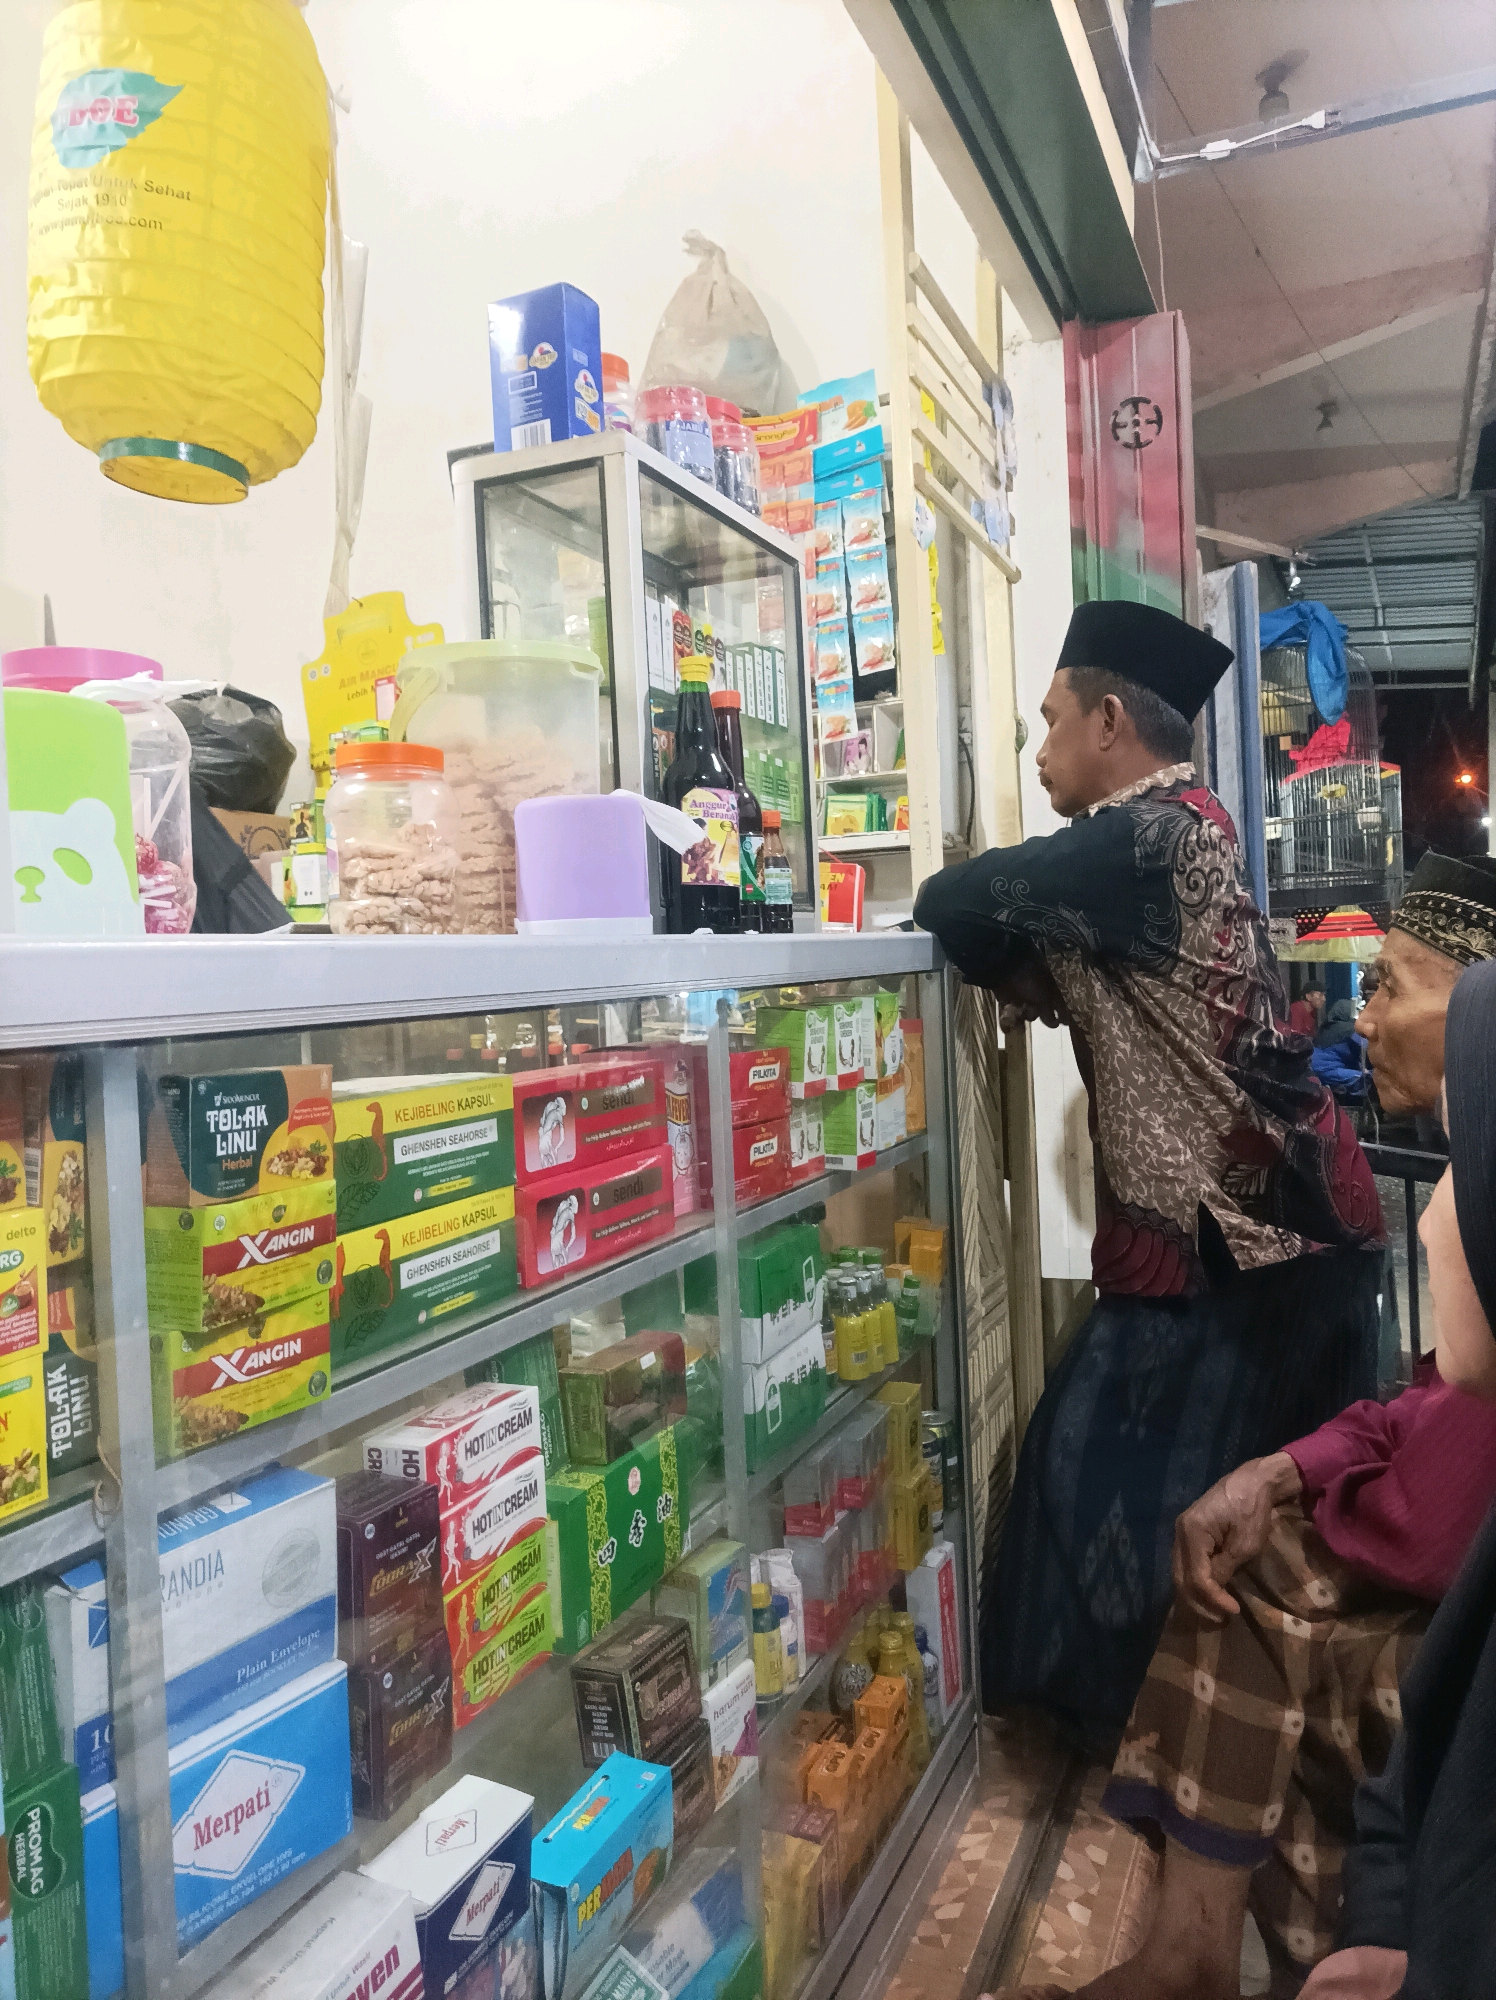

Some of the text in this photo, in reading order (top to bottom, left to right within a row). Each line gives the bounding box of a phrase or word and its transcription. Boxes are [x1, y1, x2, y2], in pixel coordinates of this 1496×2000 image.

[57, 193, 128, 212] Sejak 1910
[93, 175, 138, 190] Untuk
[143, 179, 191, 201] Sehat
[339, 663, 399, 690] AIR MANCU
[347, 687, 368, 701] Lebih
[689, 799, 727, 812] Anggur
[752, 1067, 777, 1080] PILKITA
[206, 1105, 269, 1133] TOLAK
[394, 1093, 495, 1123] KEJIBELING KAPSUL
[216, 1129, 258, 1157] LINU
[221, 1154, 253, 1171] Herbal
[400, 1127, 488, 1157] GHENSHEN SEAHORSE
[753, 1141, 775, 1157] PILKITA
[612, 1176, 644, 1203] sendi
[401, 1205, 498, 1247] KEJIBELING KAPSUL
[236, 1225, 315, 1269] XANGIN
[406, 1239, 491, 1280] GHENSHEN SEAHORSE
[211, 1338, 302, 1390] XANGIN
[47, 1362, 73, 1459] TOLAK
[69, 1374, 93, 1438] LINU
[464, 1438, 485, 1461] HOT
[498, 1407, 533, 1442] CREAM
[472, 1511, 492, 1539] HOT
[504, 1479, 539, 1520] CREAM
[159, 1548, 225, 1603] RANDIA
[482, 1544, 542, 1610] HOT IN CREAM
[237, 1656, 268, 1683] Plain
[270, 1628, 321, 1664] Envelope
[472, 1613, 545, 1683] HOT IN CREAM
[713, 1691, 740, 1721] harum
[193, 1780, 271, 1851] Merpati
[434, 1816, 470, 1847] Merpati
[15, 1832, 27, 1882] HERBAL
[27, 1807, 45, 1895] PROMAG
[465, 1874, 502, 1927] Merpati
